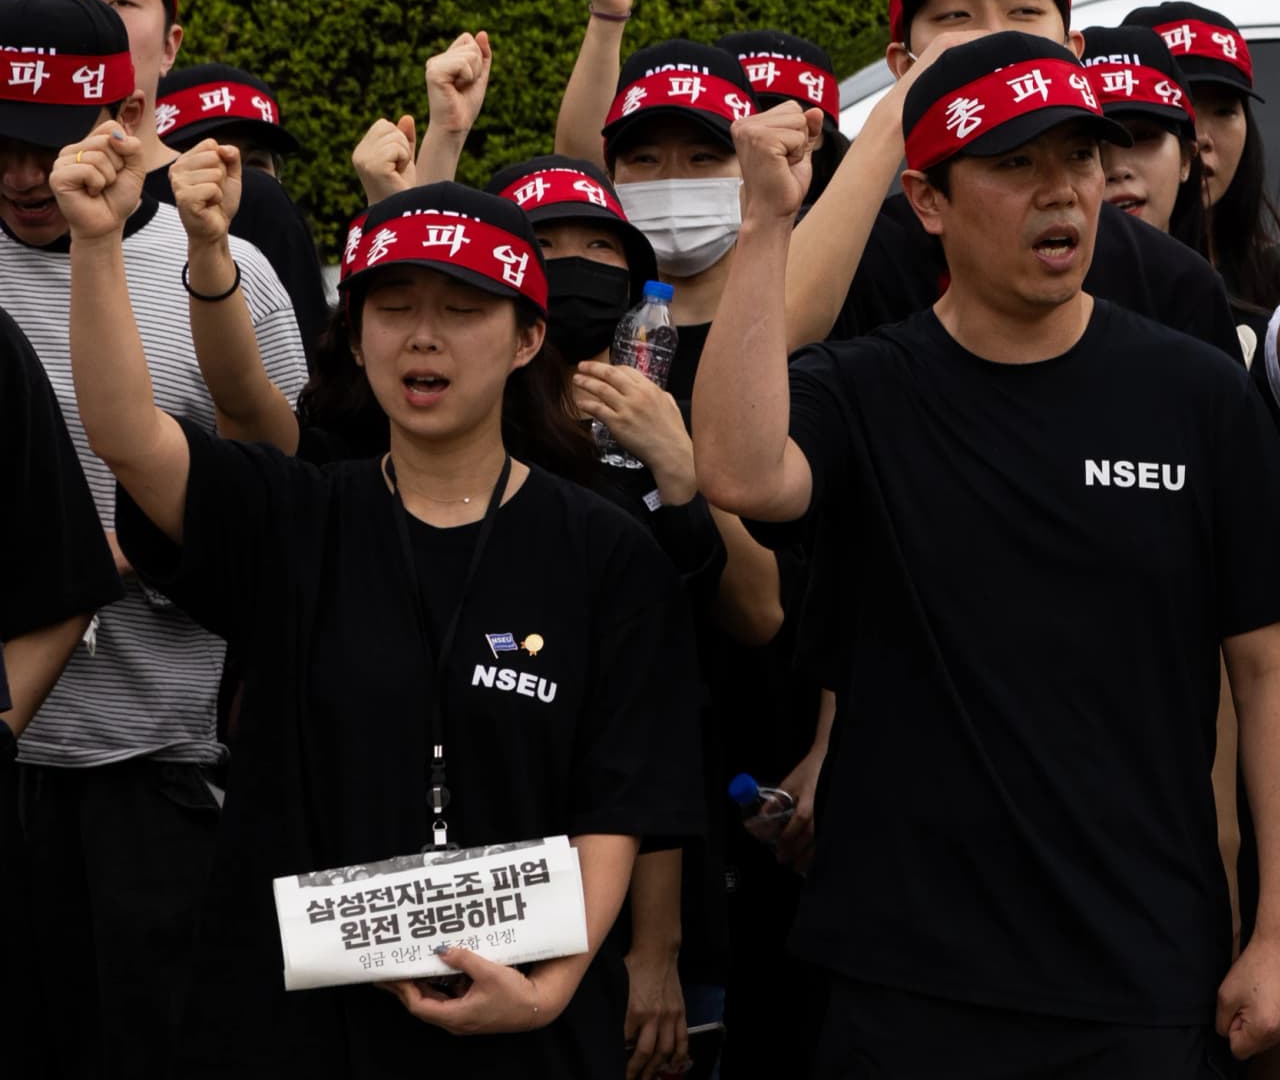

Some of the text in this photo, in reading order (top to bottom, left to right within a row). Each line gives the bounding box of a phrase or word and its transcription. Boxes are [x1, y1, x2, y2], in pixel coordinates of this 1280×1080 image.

[946, 68, 1097, 138] 총파업
[367, 224, 528, 287] 총파업
[1085, 460, 1185, 490] NSEU
[472, 665, 557, 702] NSEU
[306, 857, 551, 924] 삼성전자노조 파업
[339, 892, 527, 951] 완전 정당하다
